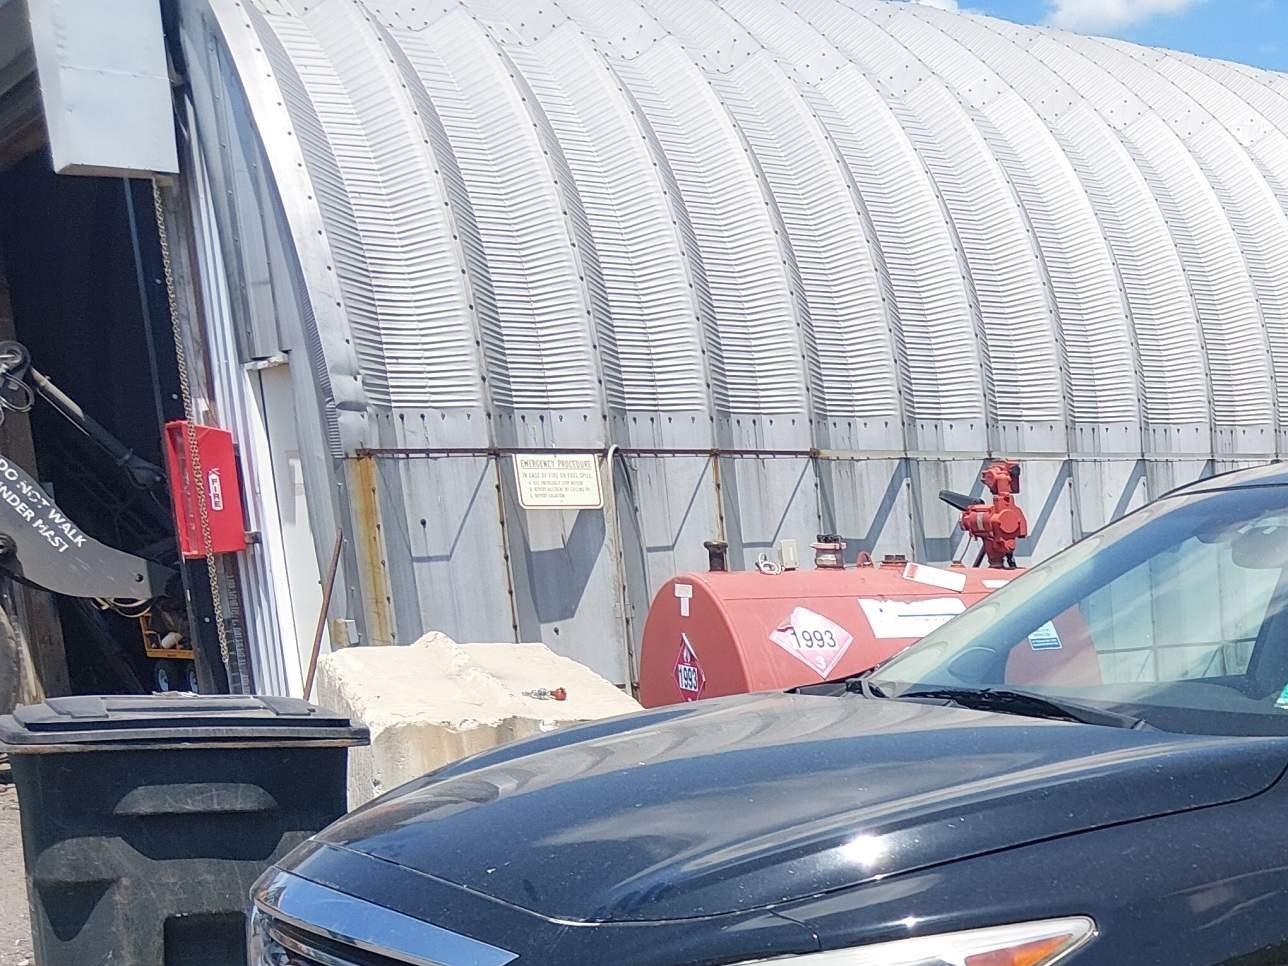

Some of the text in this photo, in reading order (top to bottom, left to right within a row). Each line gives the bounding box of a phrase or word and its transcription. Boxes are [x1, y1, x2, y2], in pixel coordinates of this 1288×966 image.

[520, 459, 592, 469] EMERGENCY PROCEDURE
[0, 458, 87, 547] DO NOT WALK
[211, 478, 221, 508] FIRE
[32, 519, 69, 552] MAST
[790, 629, 836, 648] 1993
[815, 655, 827, 669] 3
[679, 666, 698, 690] 1993
